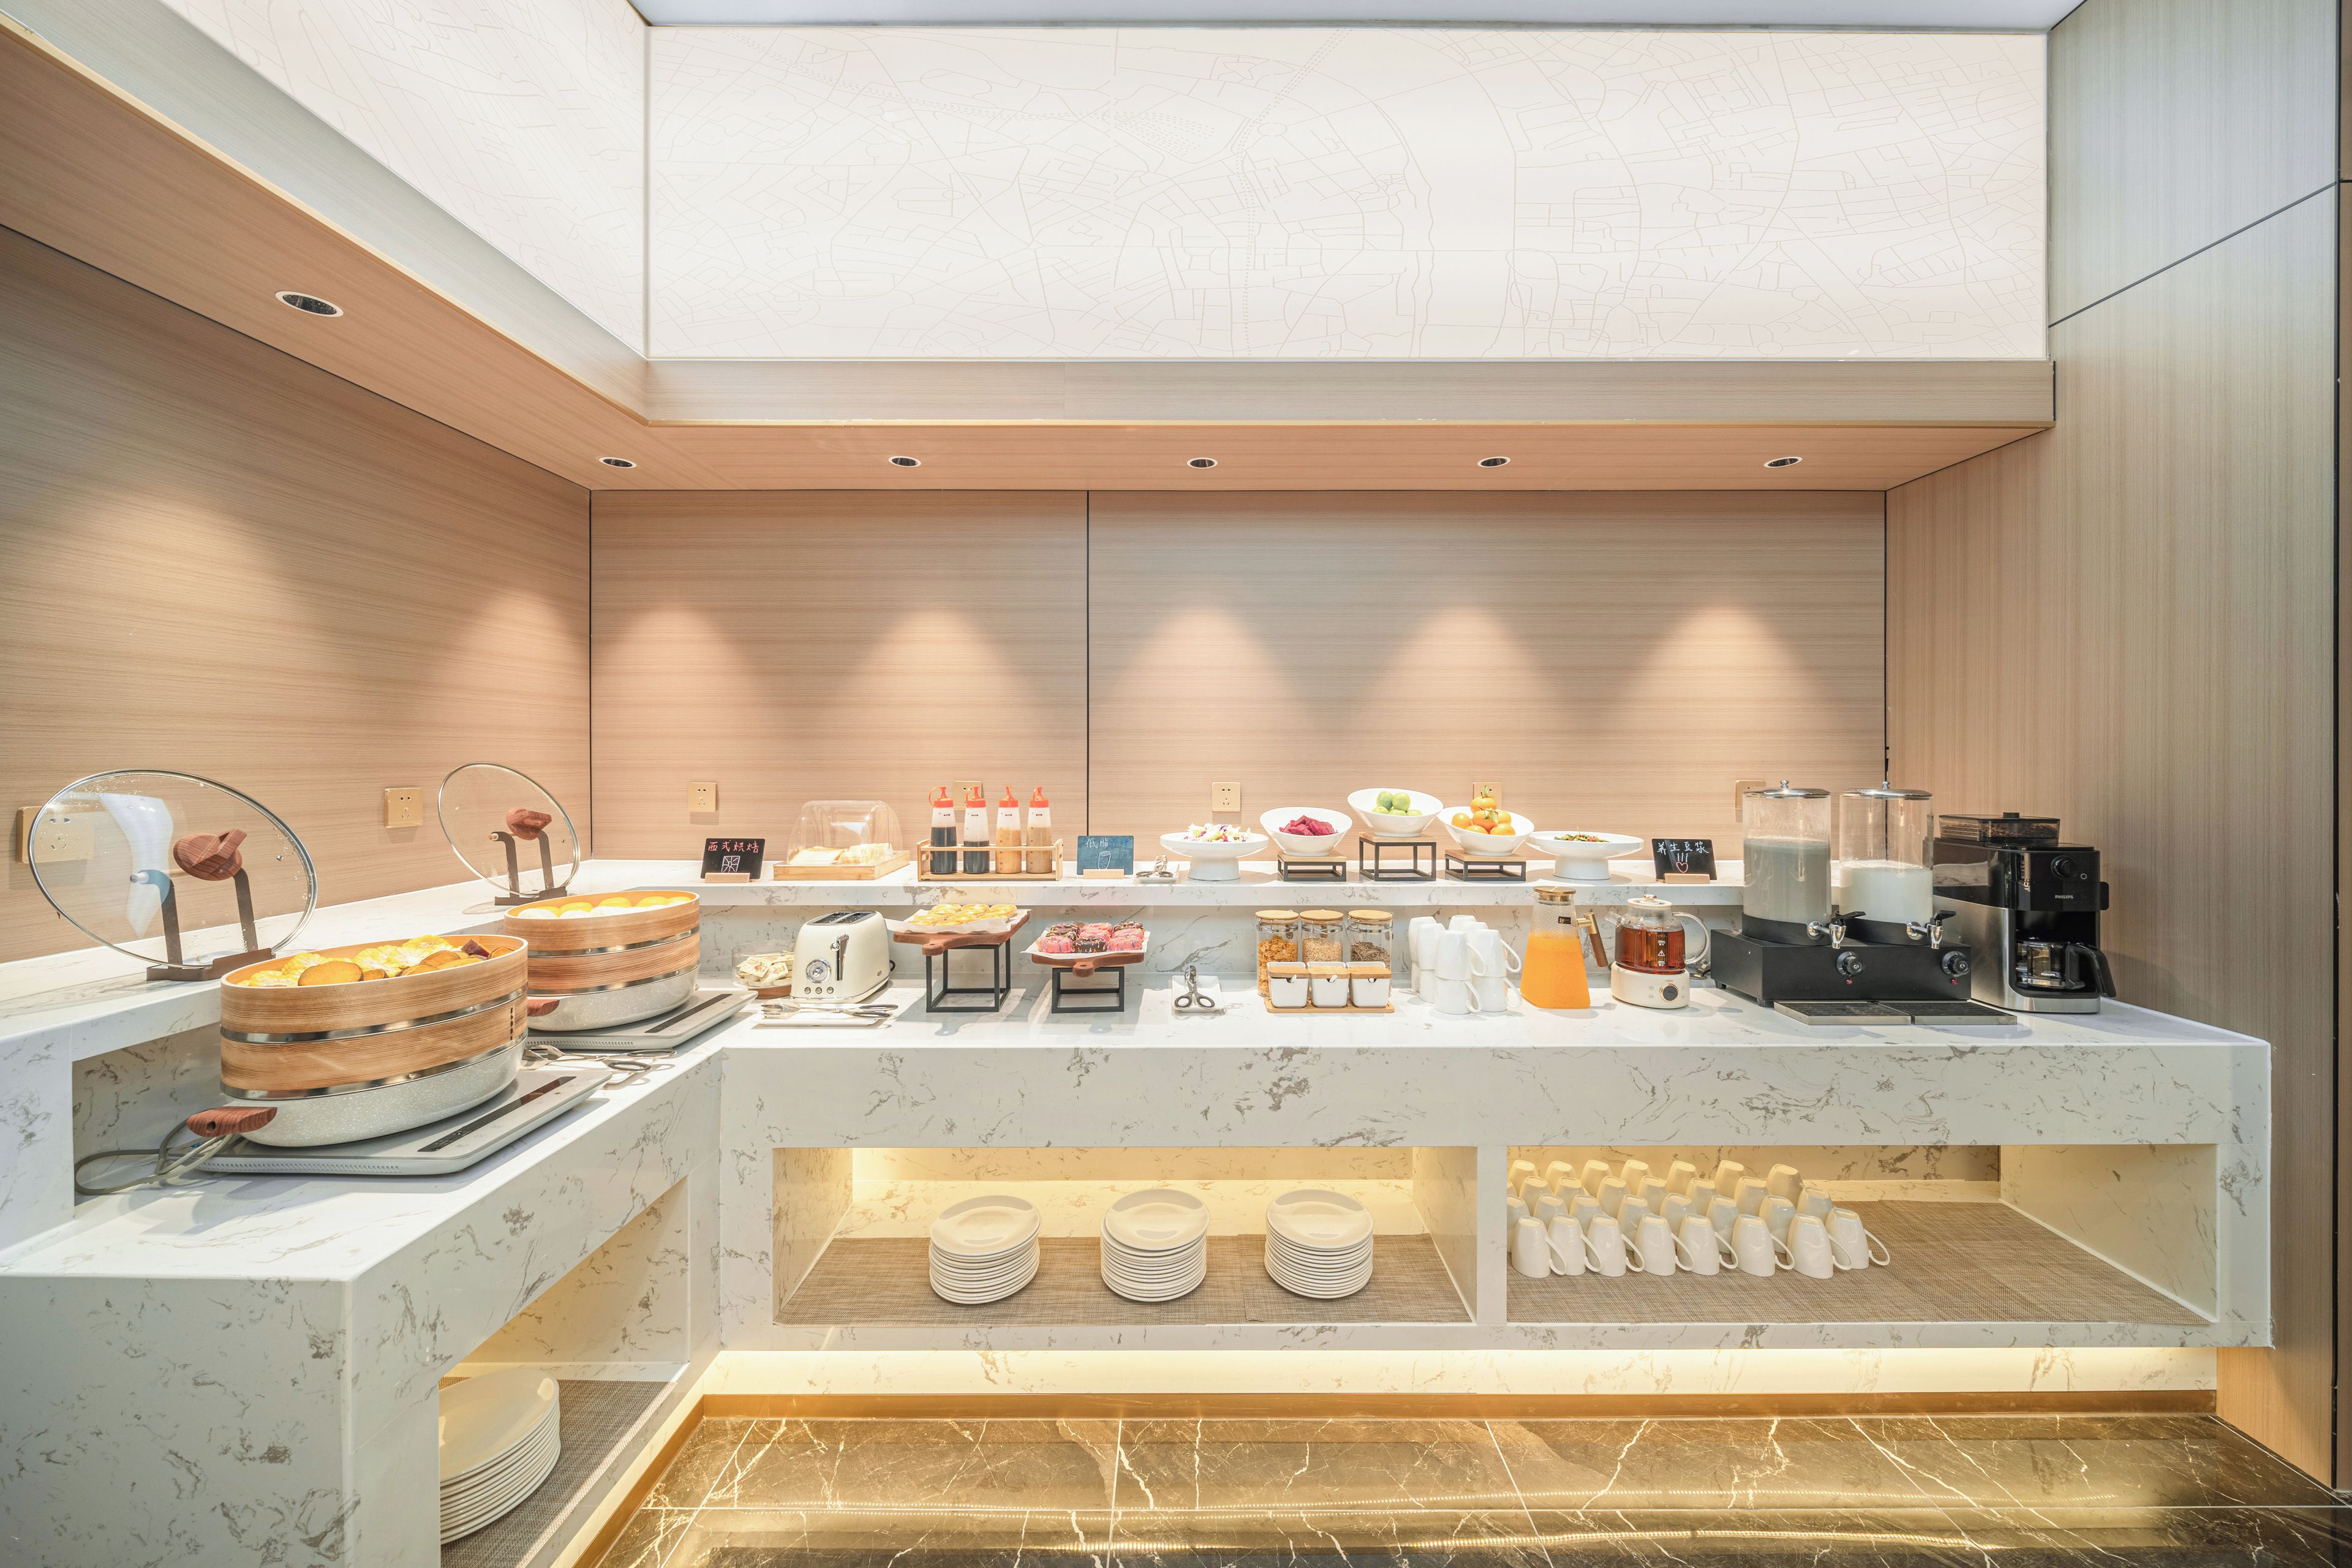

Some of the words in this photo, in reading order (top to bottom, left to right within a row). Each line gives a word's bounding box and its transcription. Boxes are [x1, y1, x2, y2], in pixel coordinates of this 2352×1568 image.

[708, 840, 760, 853] 西式烘焙
[1657, 840, 1709, 855] 养生豆浆
